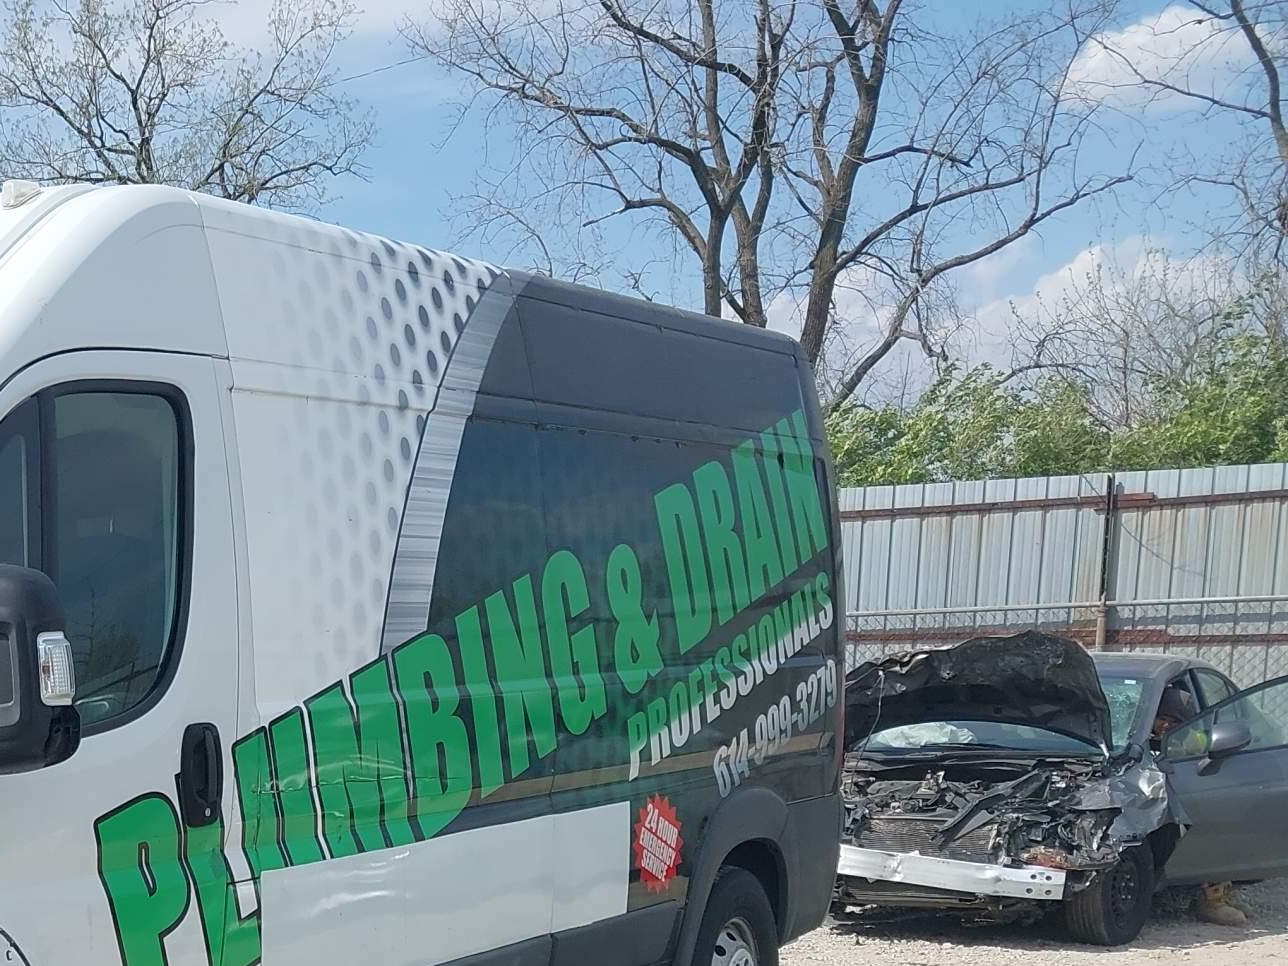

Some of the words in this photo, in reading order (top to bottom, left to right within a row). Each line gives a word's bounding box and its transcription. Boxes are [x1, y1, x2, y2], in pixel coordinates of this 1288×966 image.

[606, 543, 665, 694] &
[654, 408, 829, 653] DRAIN
[627, 571, 834, 783] PROFESSIONALS
[713, 659, 838, 799] 614-999-3279
[639, 826, 677, 869] EMERGENCY
[641, 848, 668, 882] SERVICE
[644, 803, 659, 833] 24
[656, 815, 680, 850] HOUR
